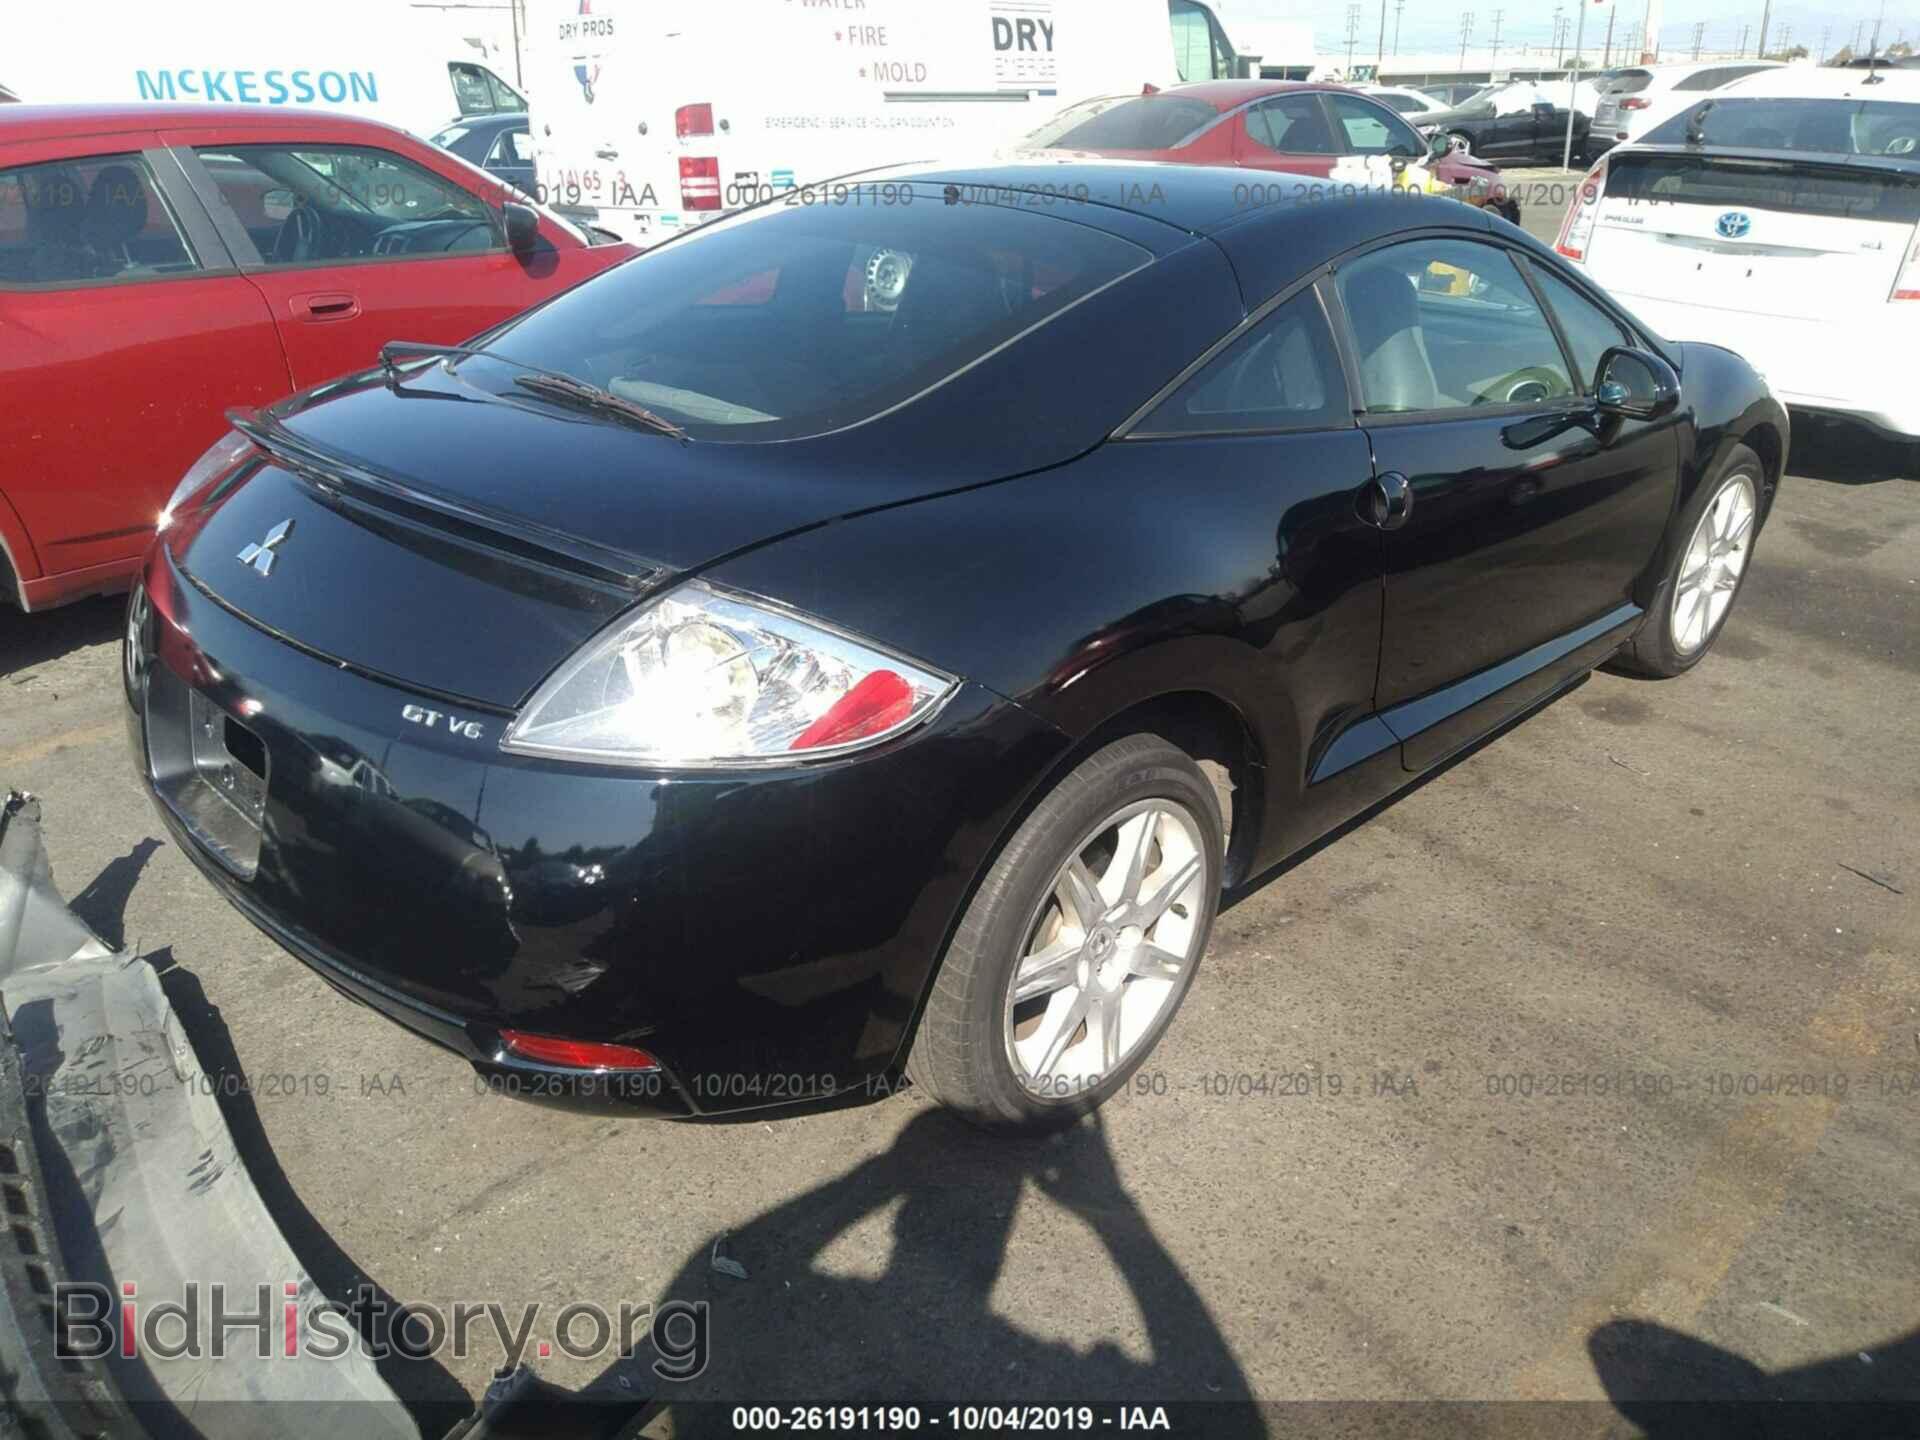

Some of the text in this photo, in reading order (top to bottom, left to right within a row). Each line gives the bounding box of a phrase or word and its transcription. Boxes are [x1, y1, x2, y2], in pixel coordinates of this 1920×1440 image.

[559, 18, 614, 40] DRY PROS
[847, 26, 888, 46] FIRE
[991, 16, 1054, 52] DRY
[873, 62, 927, 83] MOLD
[402, 704, 483, 739] GT V6
